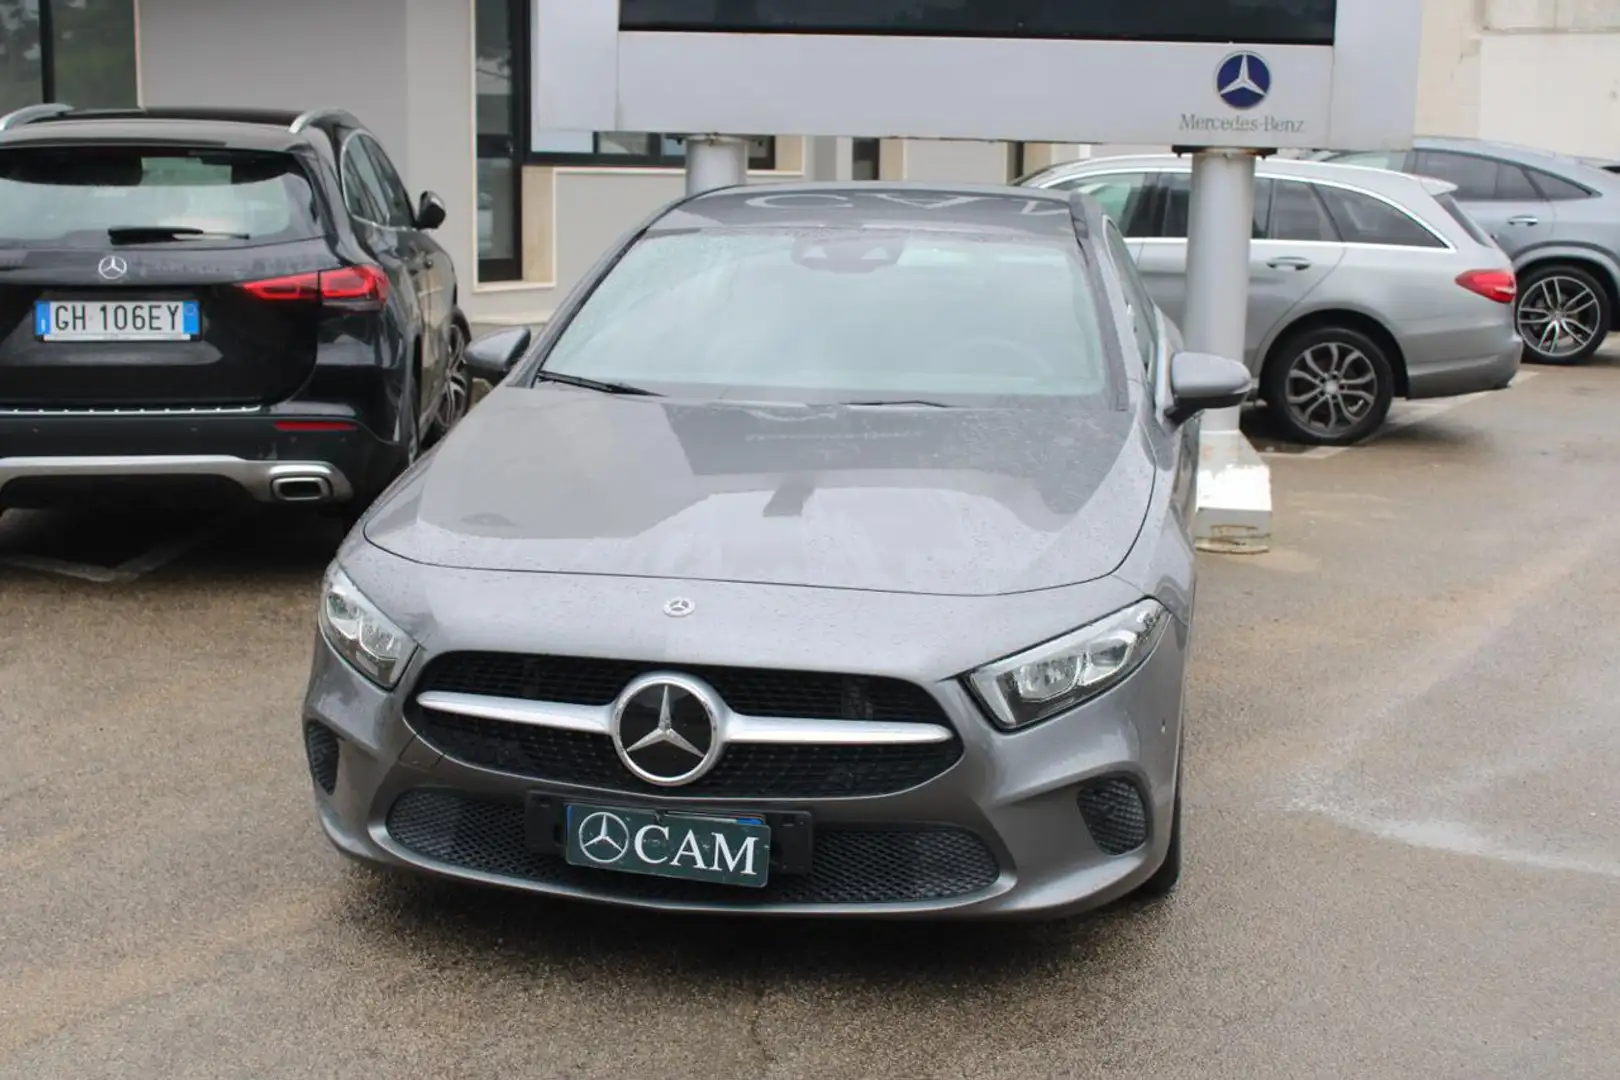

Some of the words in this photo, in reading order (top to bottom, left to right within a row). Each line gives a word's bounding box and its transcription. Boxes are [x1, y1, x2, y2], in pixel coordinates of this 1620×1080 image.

[1178, 113, 1305, 133] Mercedes-Benz
[55, 304, 86, 331] GH
[99, 304, 180, 331] 106EY
[634, 824, 759, 875] CAM
